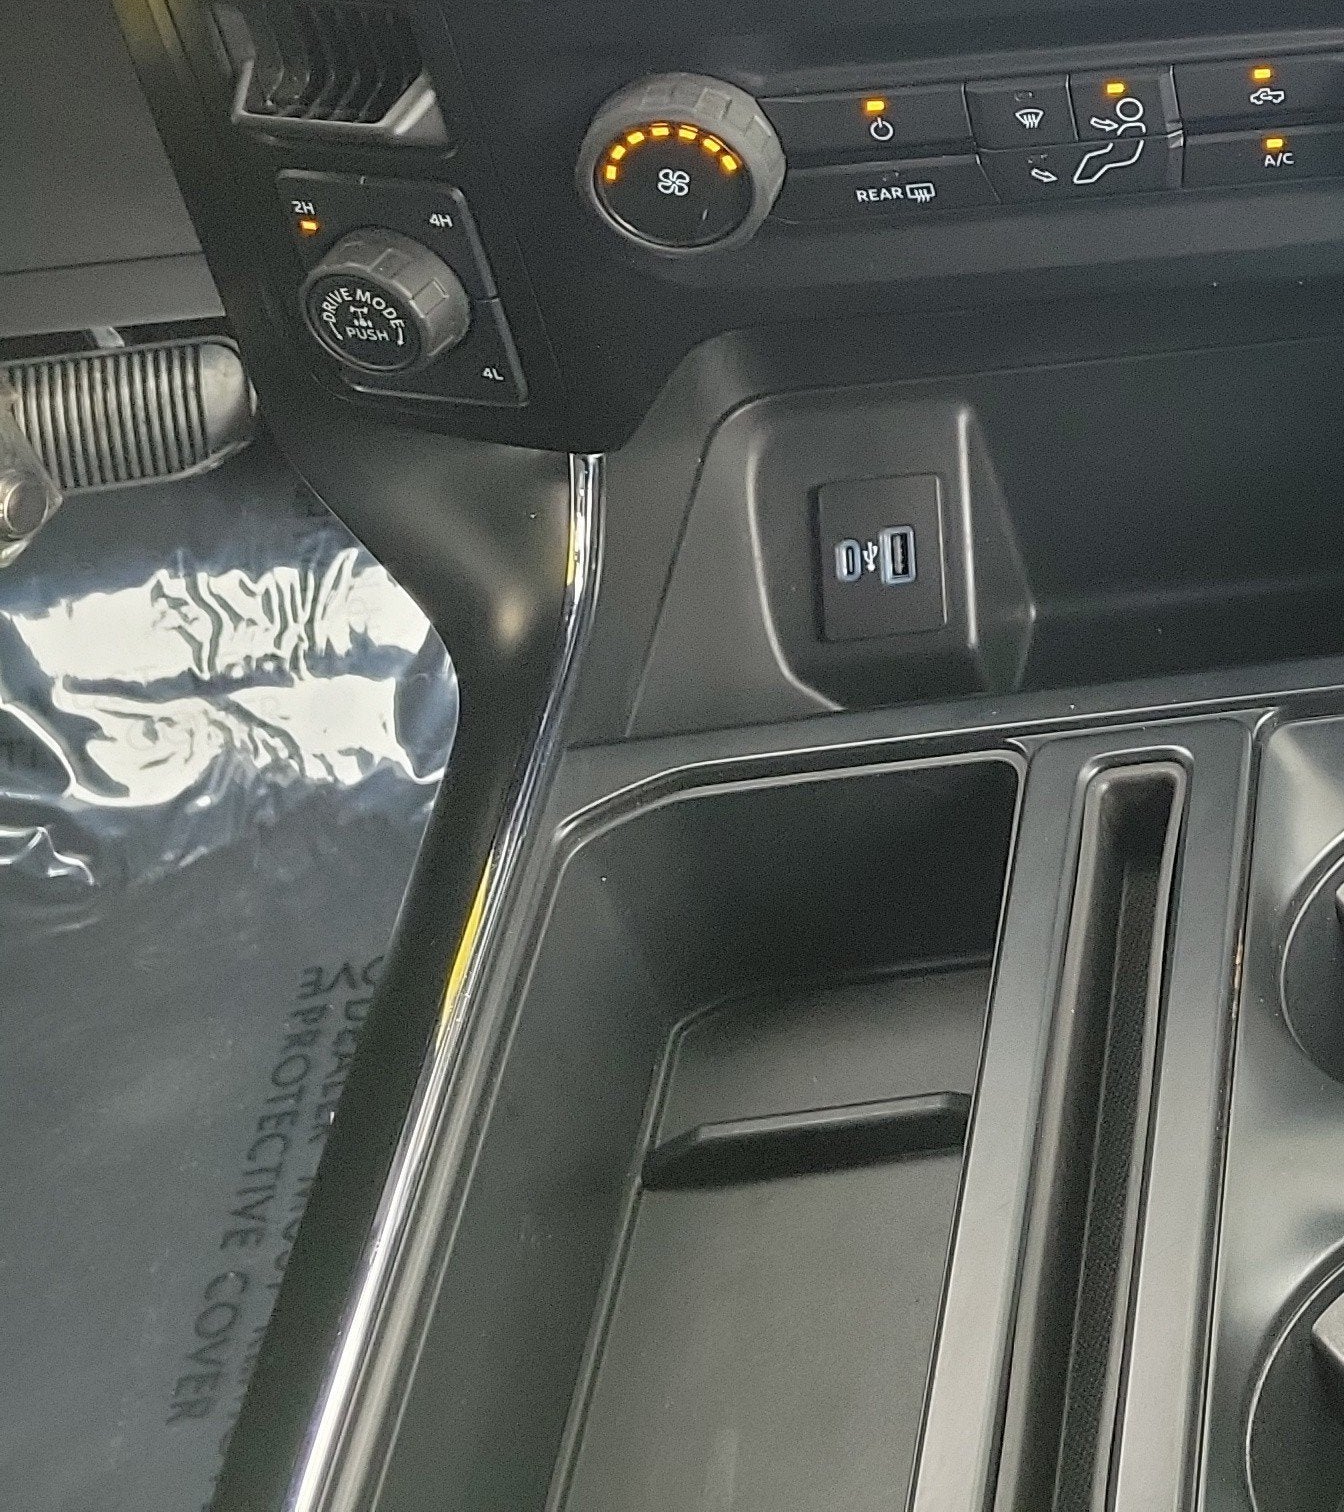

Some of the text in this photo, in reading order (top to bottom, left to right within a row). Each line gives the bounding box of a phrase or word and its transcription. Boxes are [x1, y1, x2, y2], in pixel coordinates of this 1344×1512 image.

[1264, 151, 1294, 168] A/C
[855, 183, 905, 203] REAR
[291, 200, 316, 215] 2H
[429, 214, 453, 228] 4H
[322, 287, 406, 329] DRIVE MODE
[346, 327, 390, 342] PUSH
[482, 367, 504, 381] 4L
[220, 1002, 321, 1251] PROTECTIVE
[165, 1269, 250, 1429] COVER
